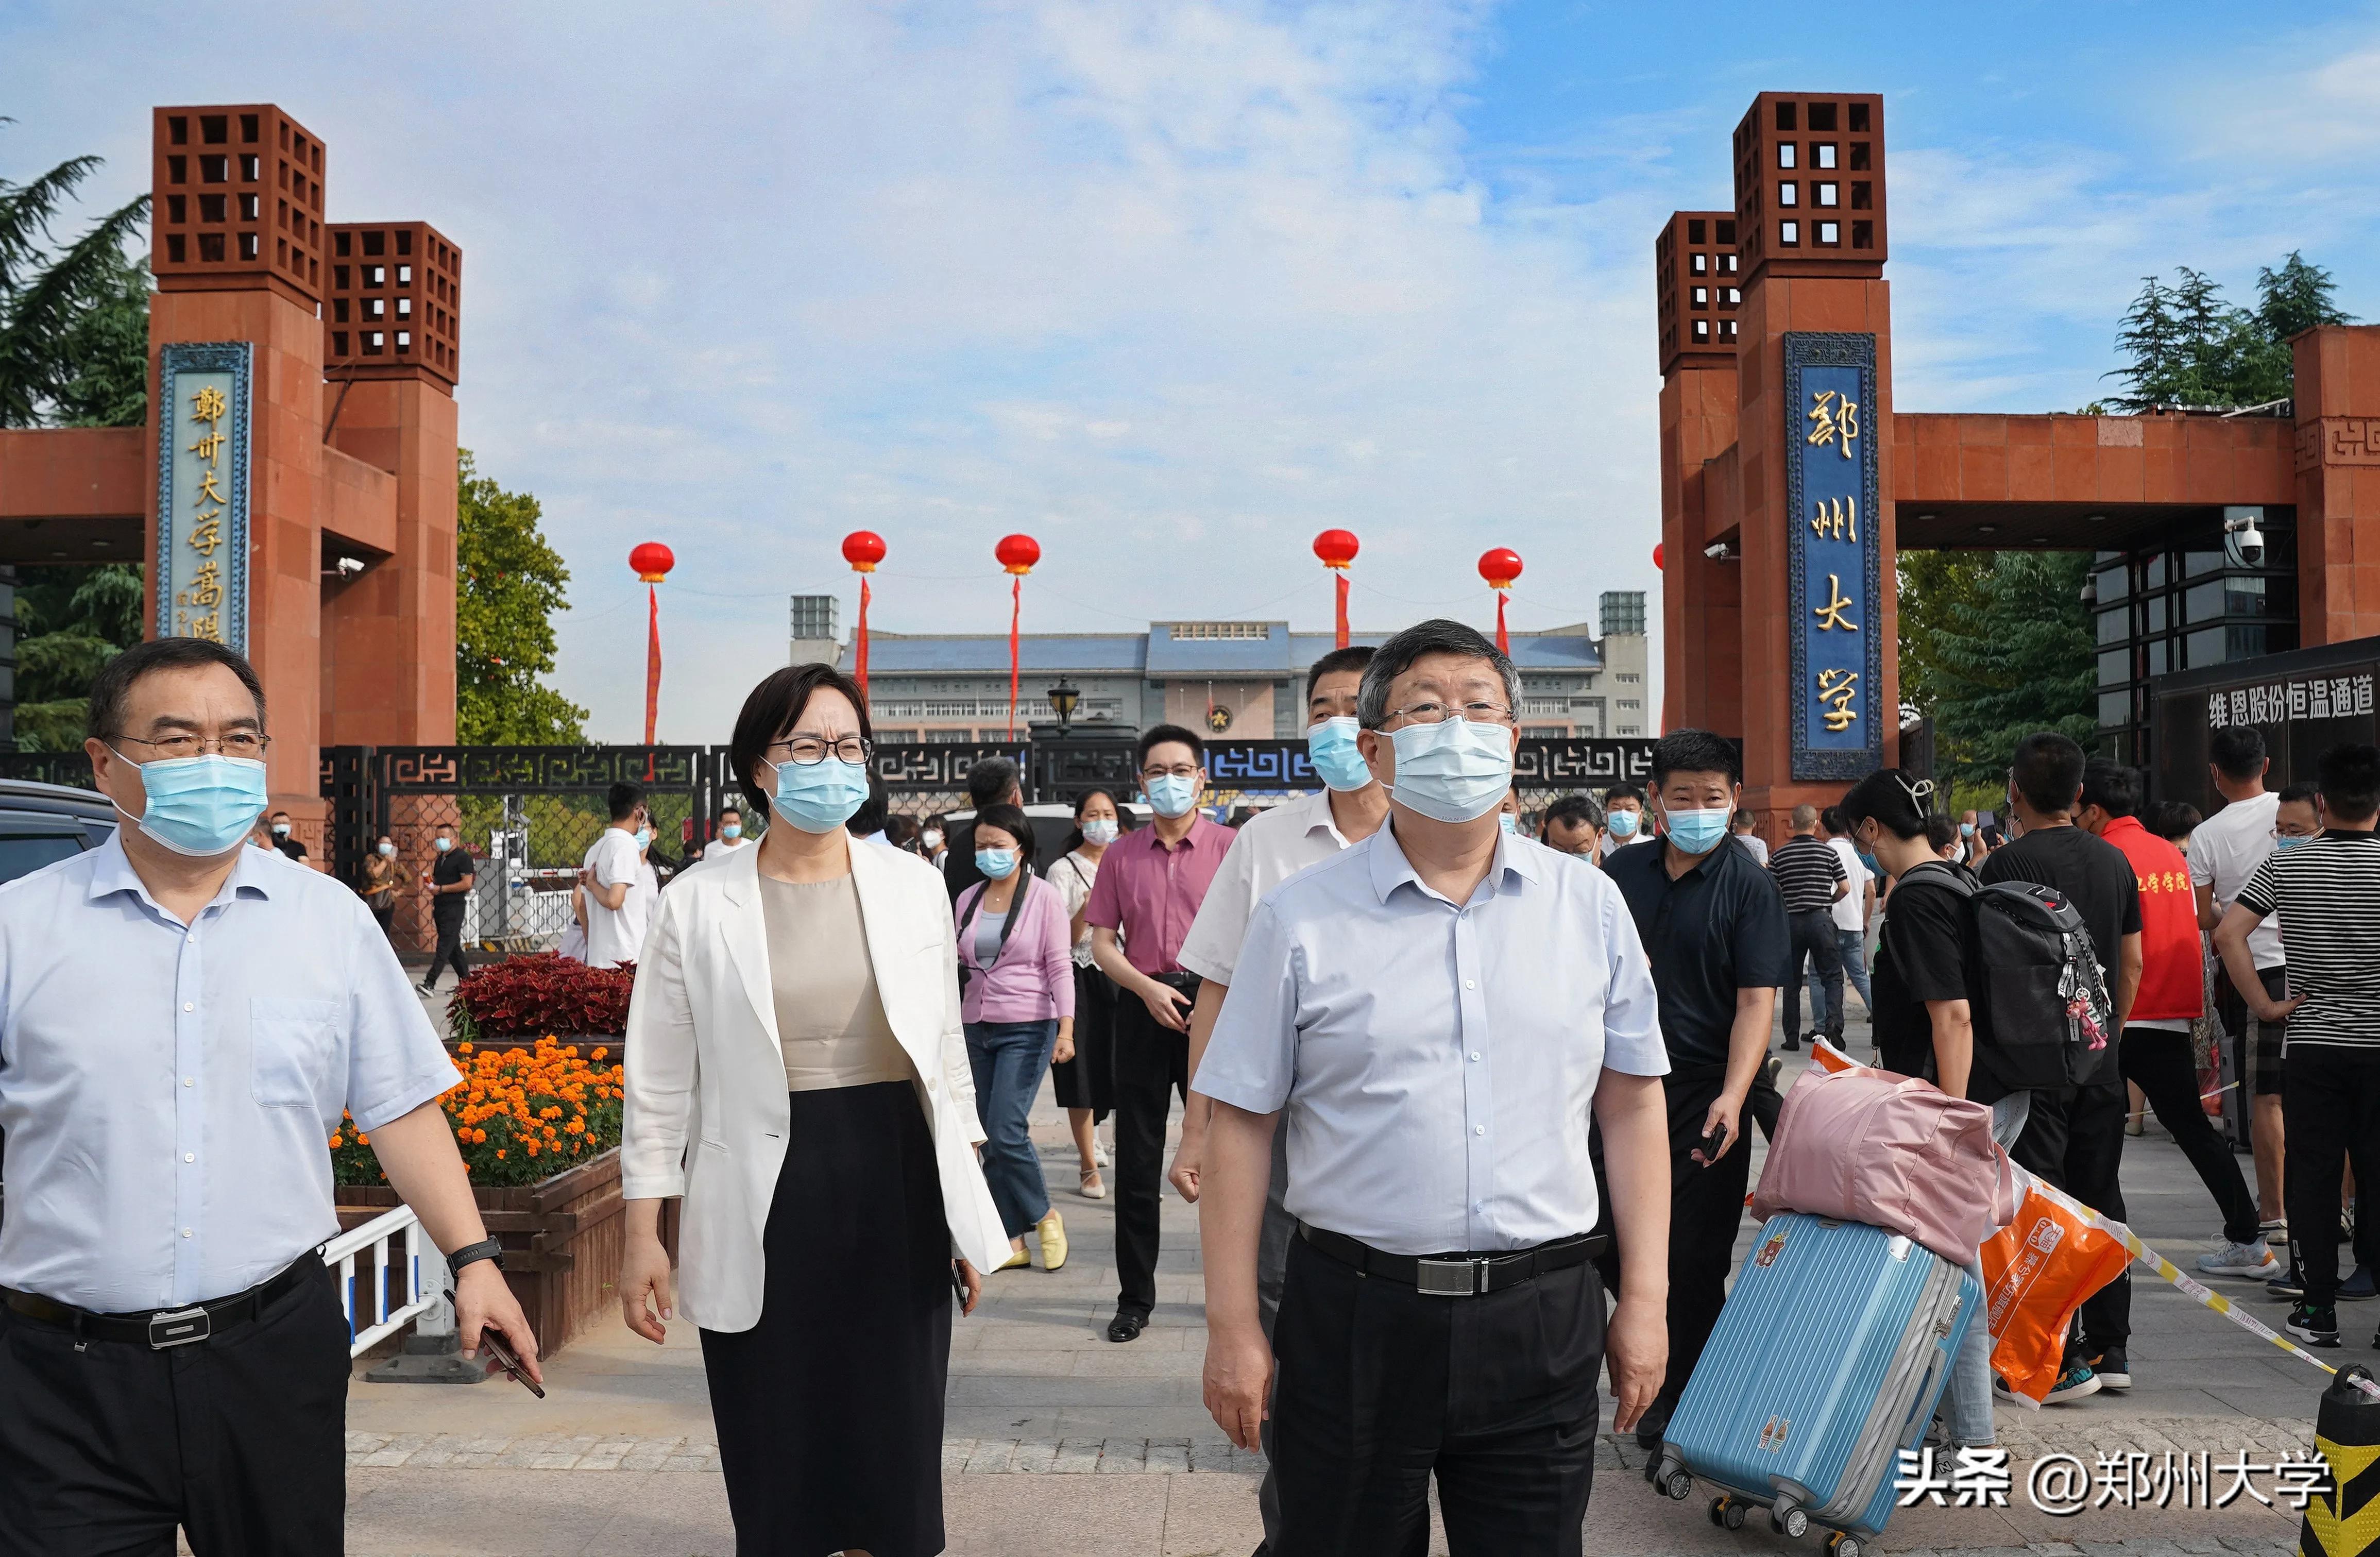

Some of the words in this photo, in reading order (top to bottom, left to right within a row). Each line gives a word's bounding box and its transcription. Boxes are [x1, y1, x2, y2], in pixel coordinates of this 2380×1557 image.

[2208, 674, 2374, 729] 维恩股份恒温通道
[2040, 1223, 2061, 1251] 天猫
